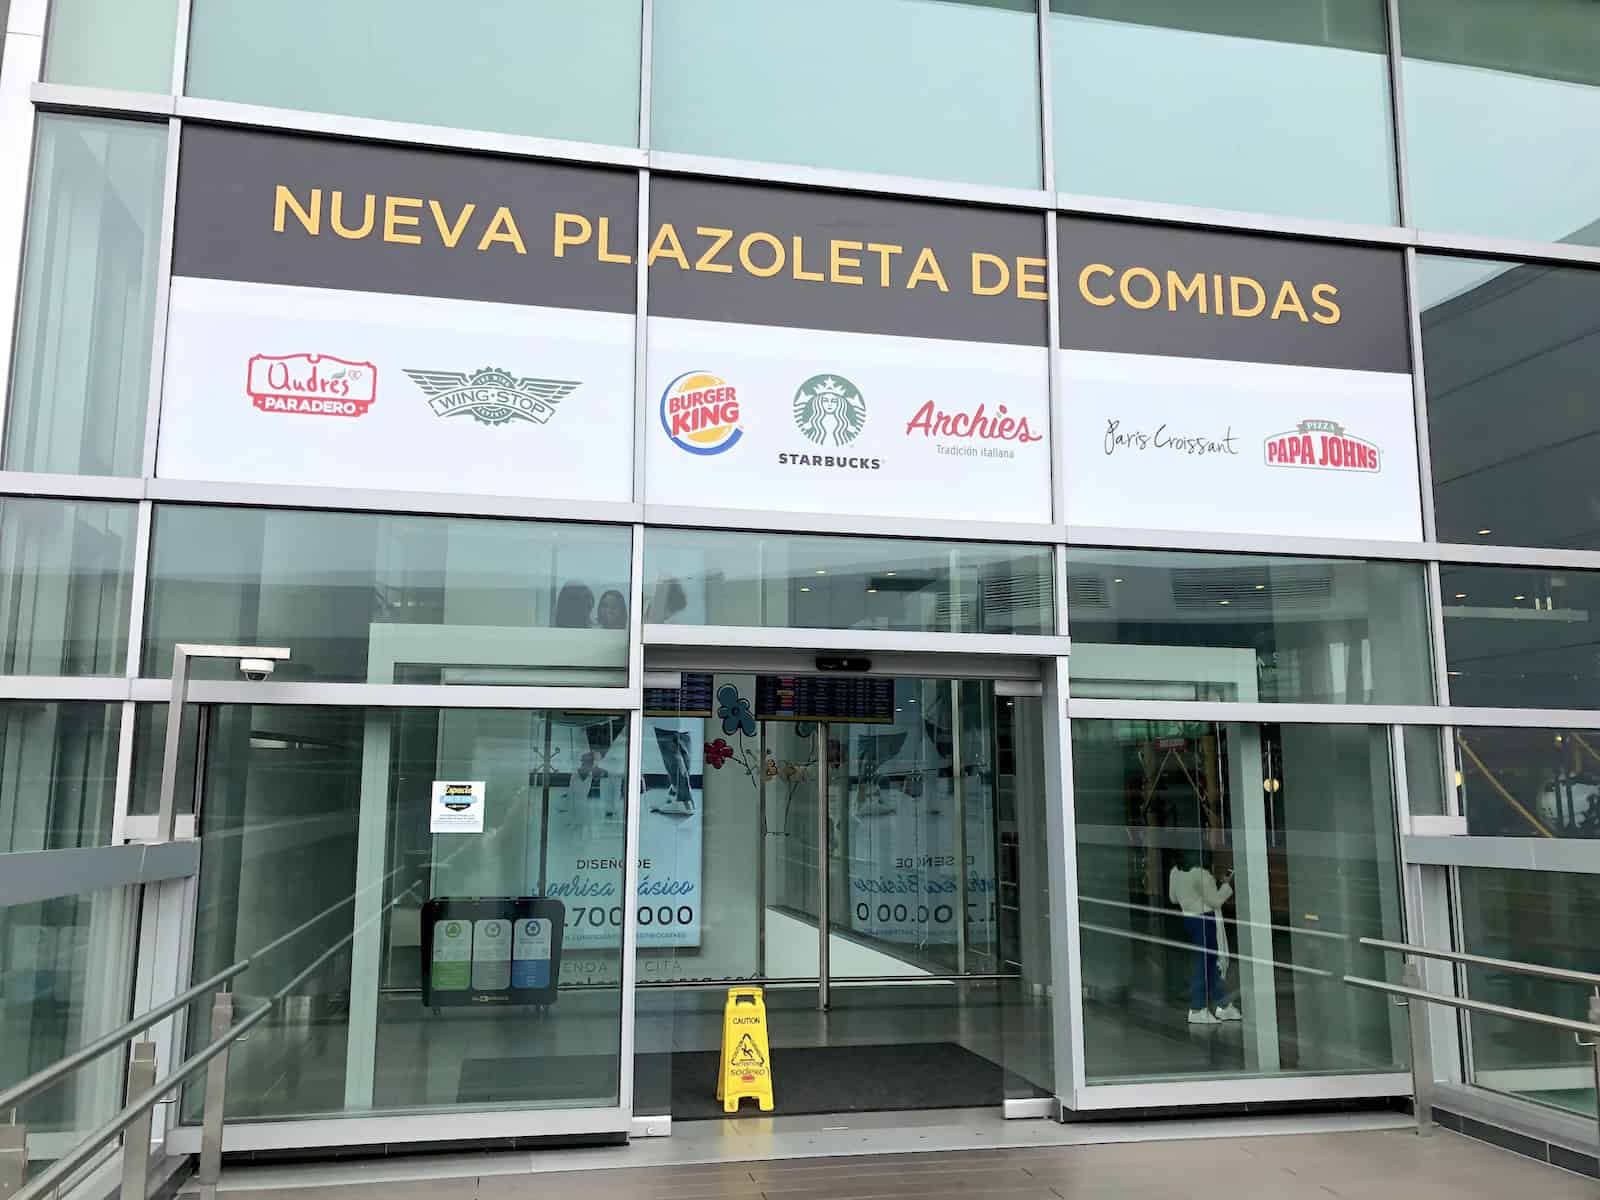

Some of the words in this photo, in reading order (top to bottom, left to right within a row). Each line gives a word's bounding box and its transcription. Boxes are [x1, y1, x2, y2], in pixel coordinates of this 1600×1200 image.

[274, 185, 526, 254] NUEVA
[554, 212, 949, 293] PLAZOLETA
[972, 252, 1048, 300] DE
[1078, 263, 1341, 325] COMIDAS
[265, 397, 357, 414] PARADERO
[669, 386, 737, 415] BURGER
[672, 401, 740, 436] KING
[906, 399, 1043, 442] Archies
[1104, 418, 1150, 456] Paris
[1153, 423, 1239, 456] Croissant
[1268, 435, 1316, 464] PAPA
[1319, 435, 1377, 469] JOHNS
[778, 452, 881, 470] STARBUCKS
[732, 1016, 760, 1024] CAUTION
